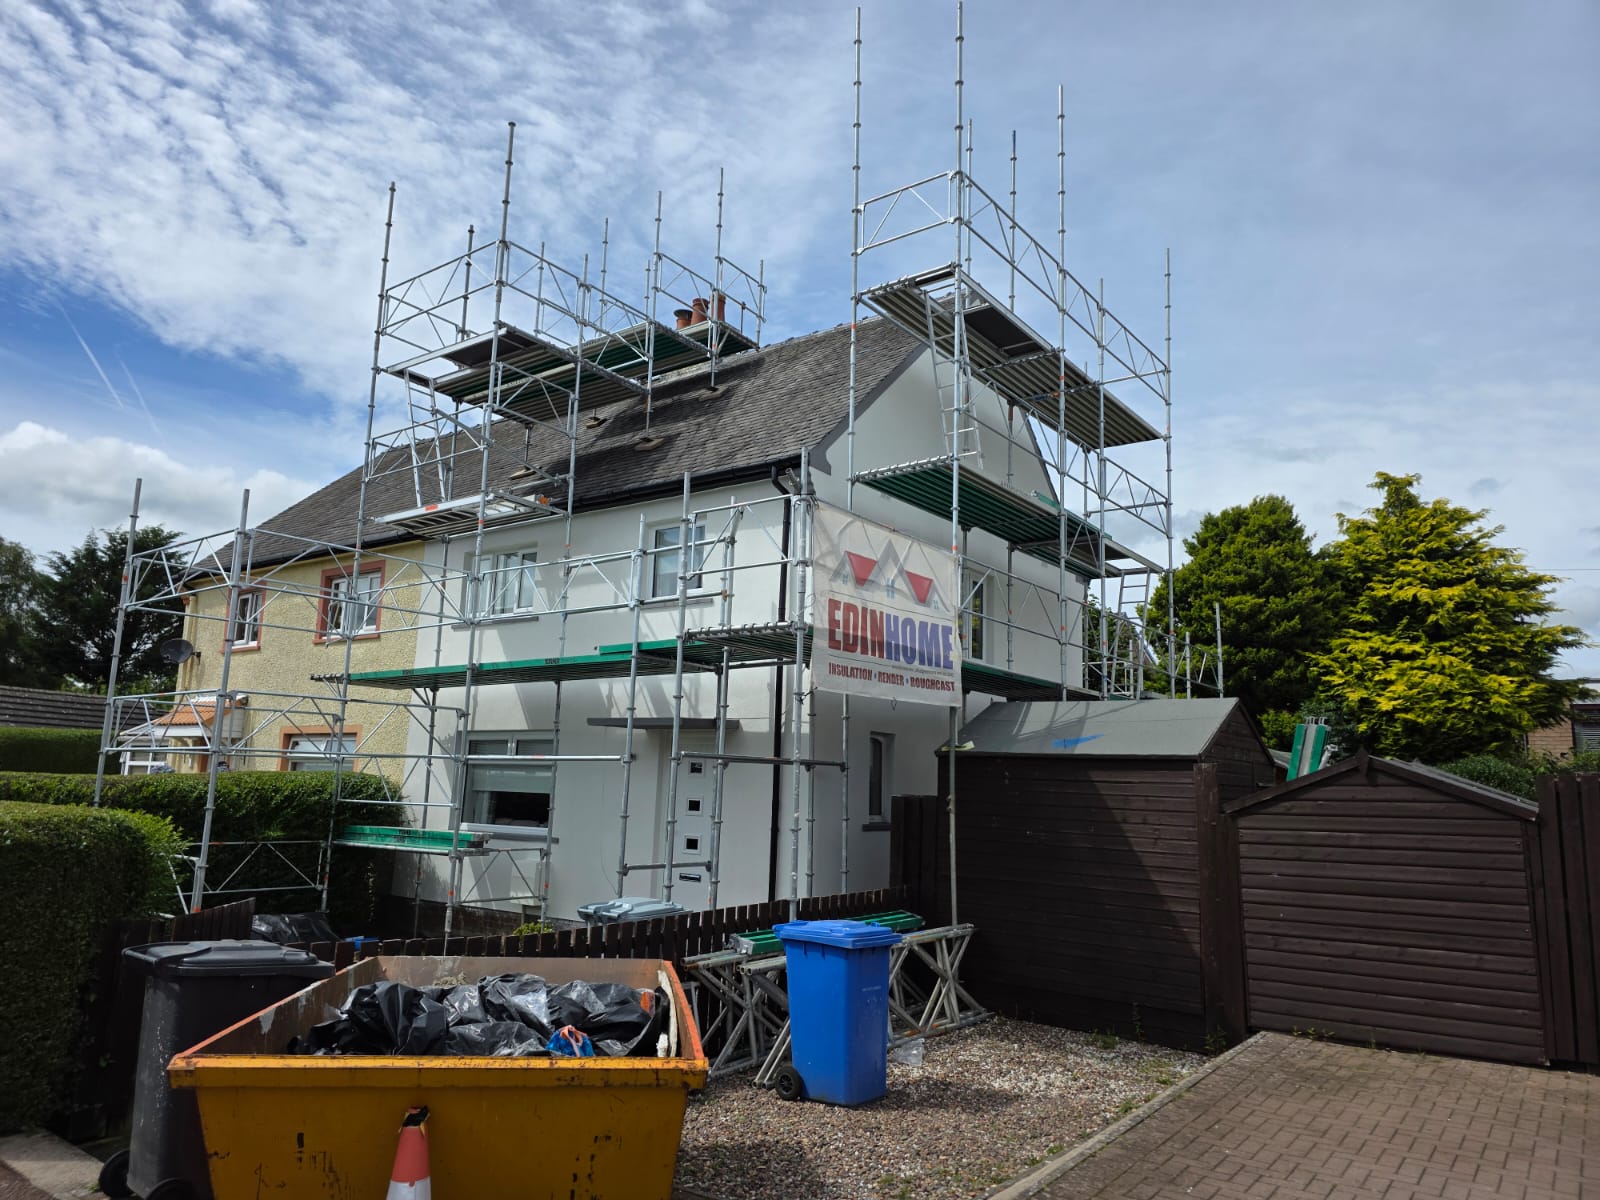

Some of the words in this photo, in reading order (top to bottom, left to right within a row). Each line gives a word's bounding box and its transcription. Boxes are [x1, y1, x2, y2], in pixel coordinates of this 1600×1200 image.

[828, 598, 953, 669] EDINHOME
[828, 662, 872, 681] INSULATION
[877, 671, 904, 686] RENDER
[910, 676, 955, 692] ROUGHCAST
